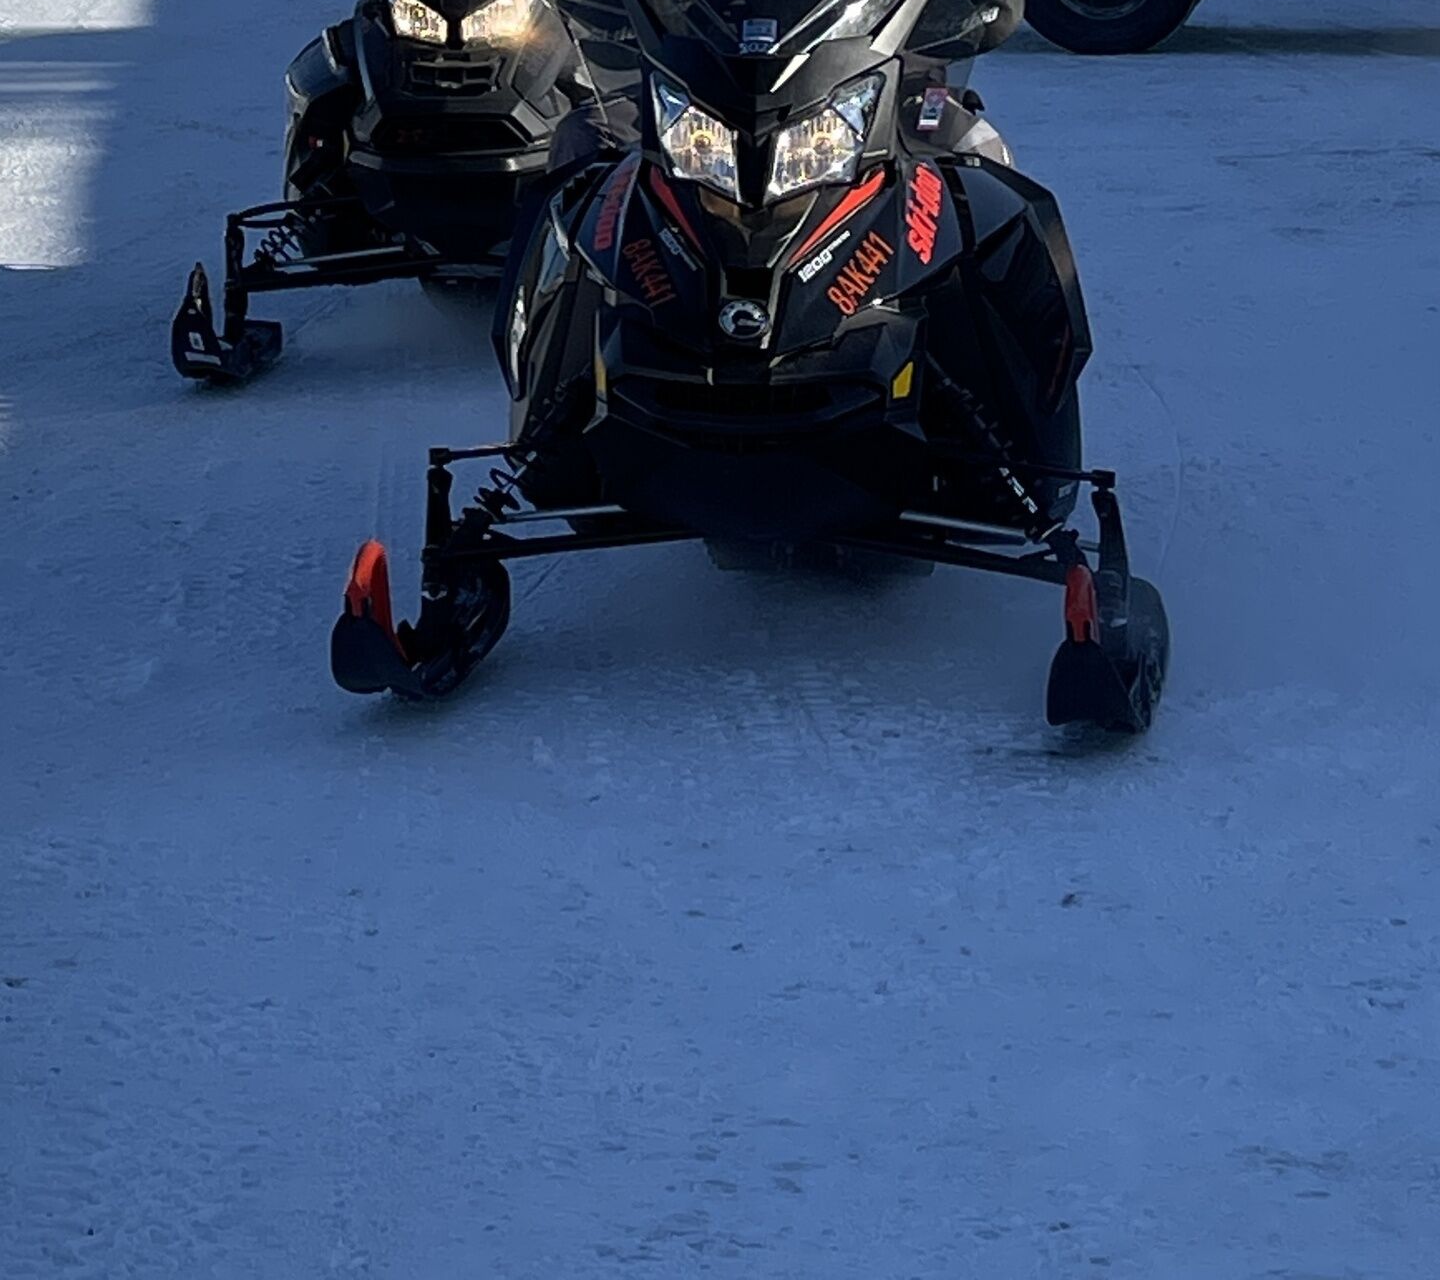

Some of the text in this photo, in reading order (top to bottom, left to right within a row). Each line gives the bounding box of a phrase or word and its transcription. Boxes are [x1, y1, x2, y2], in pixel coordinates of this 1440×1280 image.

[622, 239, 677, 308] 8AK441
[798, 248, 833, 283] 1200
[827, 231, 894, 315] 8AK441
